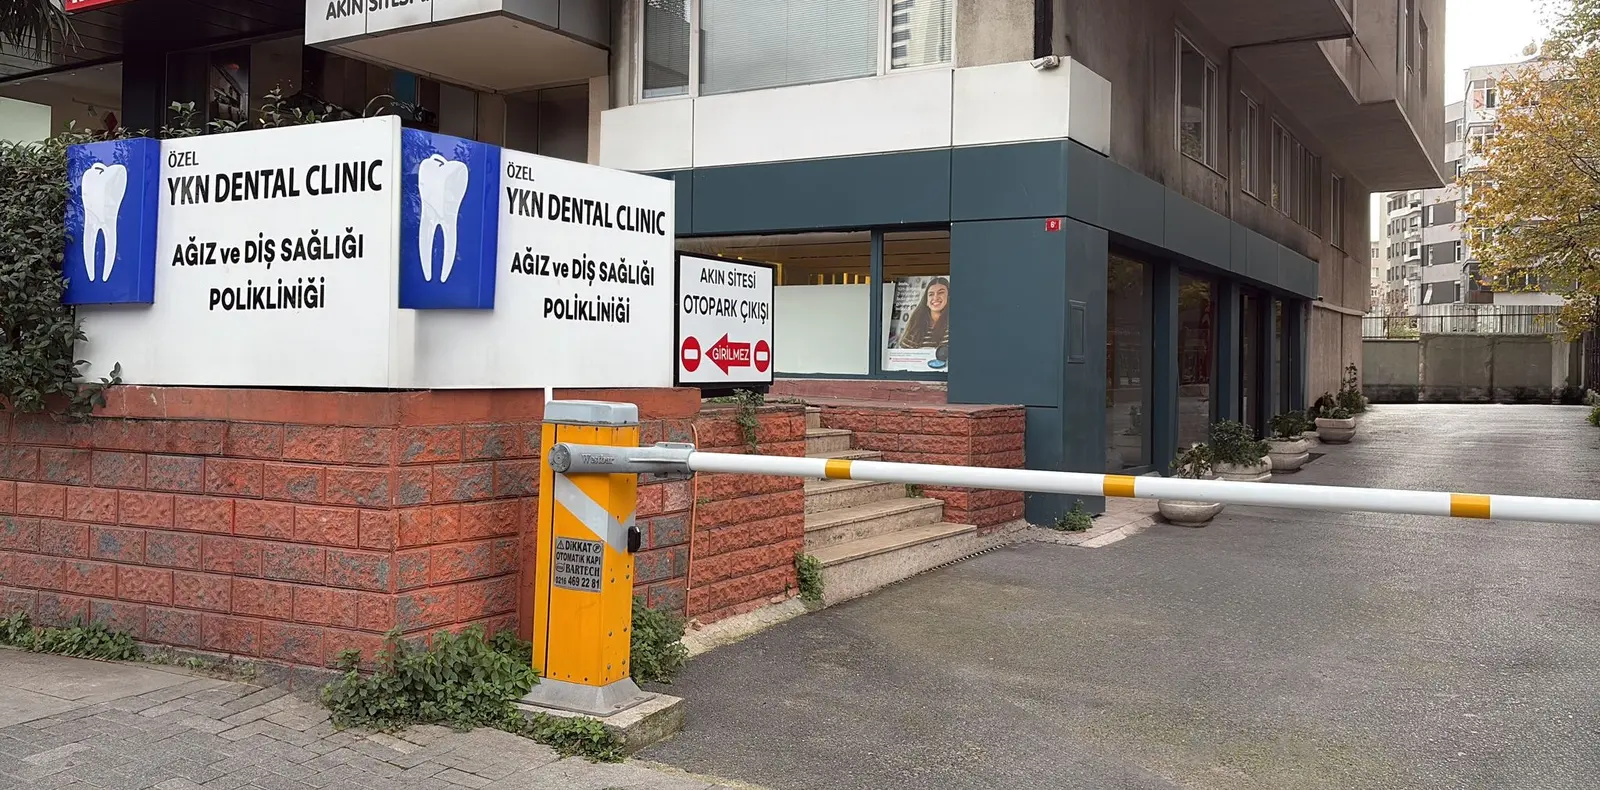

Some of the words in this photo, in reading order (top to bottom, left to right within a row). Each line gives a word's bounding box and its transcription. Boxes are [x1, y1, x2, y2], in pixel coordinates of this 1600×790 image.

[326, 0, 363, 20] AKIN
[168, 150, 199, 168] ÖZEL
[506, 161, 534, 182] ÖZEL
[167, 174, 210, 206] YKN
[214, 167, 300, 203] DENTAL
[305, 159, 383, 196] CLINIC
[506, 186, 544, 219] YKN
[547, 193, 613, 229] DENTAL
[616, 204, 666, 236] CLINIC
[171, 235, 217, 267] AĞIZ
[219, 246, 241, 265] ve
[244, 231, 276, 270] DİŞ
[280, 226, 364, 262] SAĞLIĞI
[510, 246, 550, 277] AĞIZ
[552, 261, 569, 278] ve
[571, 252, 596, 287] DİŞ
[598, 257, 654, 286] SAĞLIĞI
[700, 267, 725, 285] AKIN
[727, 268, 756, 289] SİTESİ
[209, 276, 325, 311] POLİKLİNİĞİ
[543, 293, 630, 324] POLİKLİNİĞİ
[683, 294, 738, 318] OTOPARK
[740, 300, 769, 325] ÇIKIŞI
[712, 344, 750, 361] GİRİLMEZ
[565, 540, 592, 553] DİKKAT
[565, 563, 600, 577] BARTECH
[586, 555, 601, 565] KAPI
[568, 575, 580, 587] 469
[581, 577, 590, 588] 22
[591, 578, 600, 589] 81
